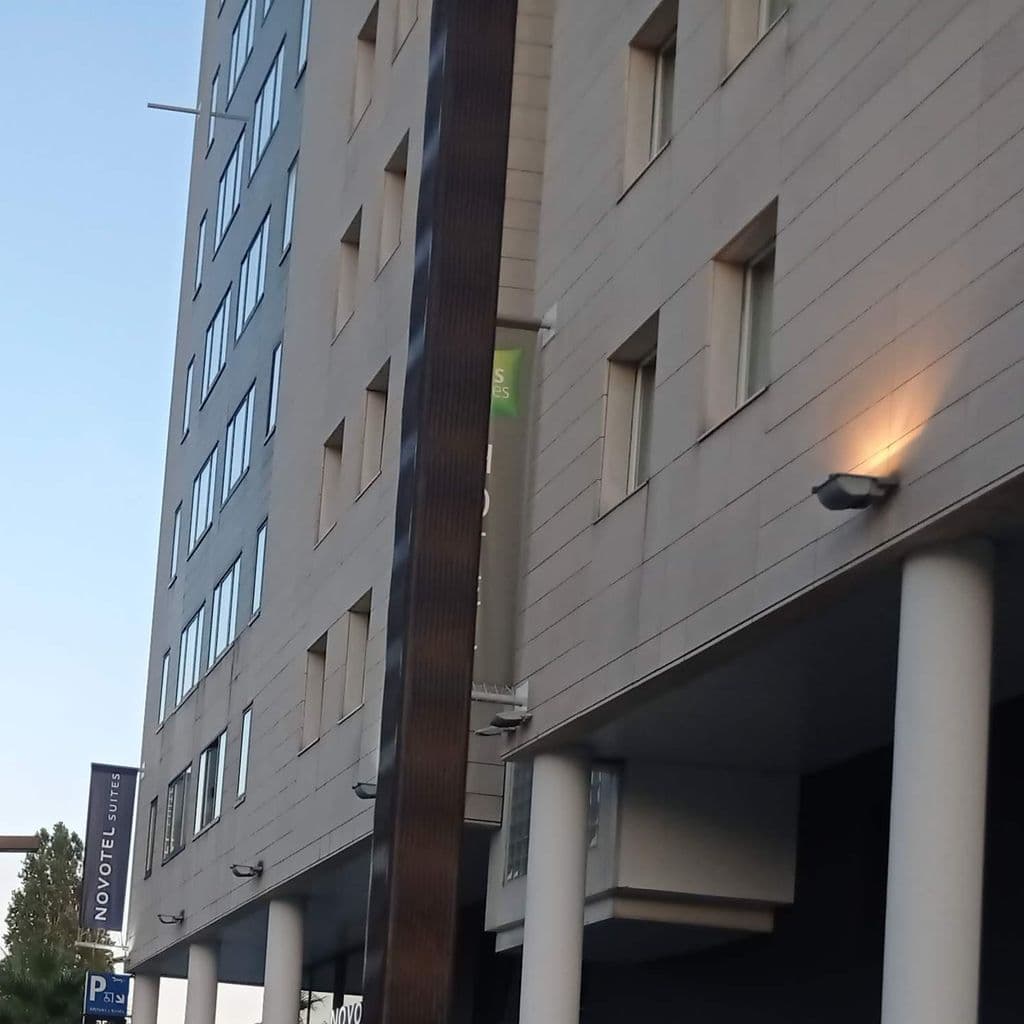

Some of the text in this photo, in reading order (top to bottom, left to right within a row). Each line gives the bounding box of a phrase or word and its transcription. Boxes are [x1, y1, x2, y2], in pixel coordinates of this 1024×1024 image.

[94, 772, 121, 922] NOVOTEL SUITES
[89, 975, 107, 1002] P
